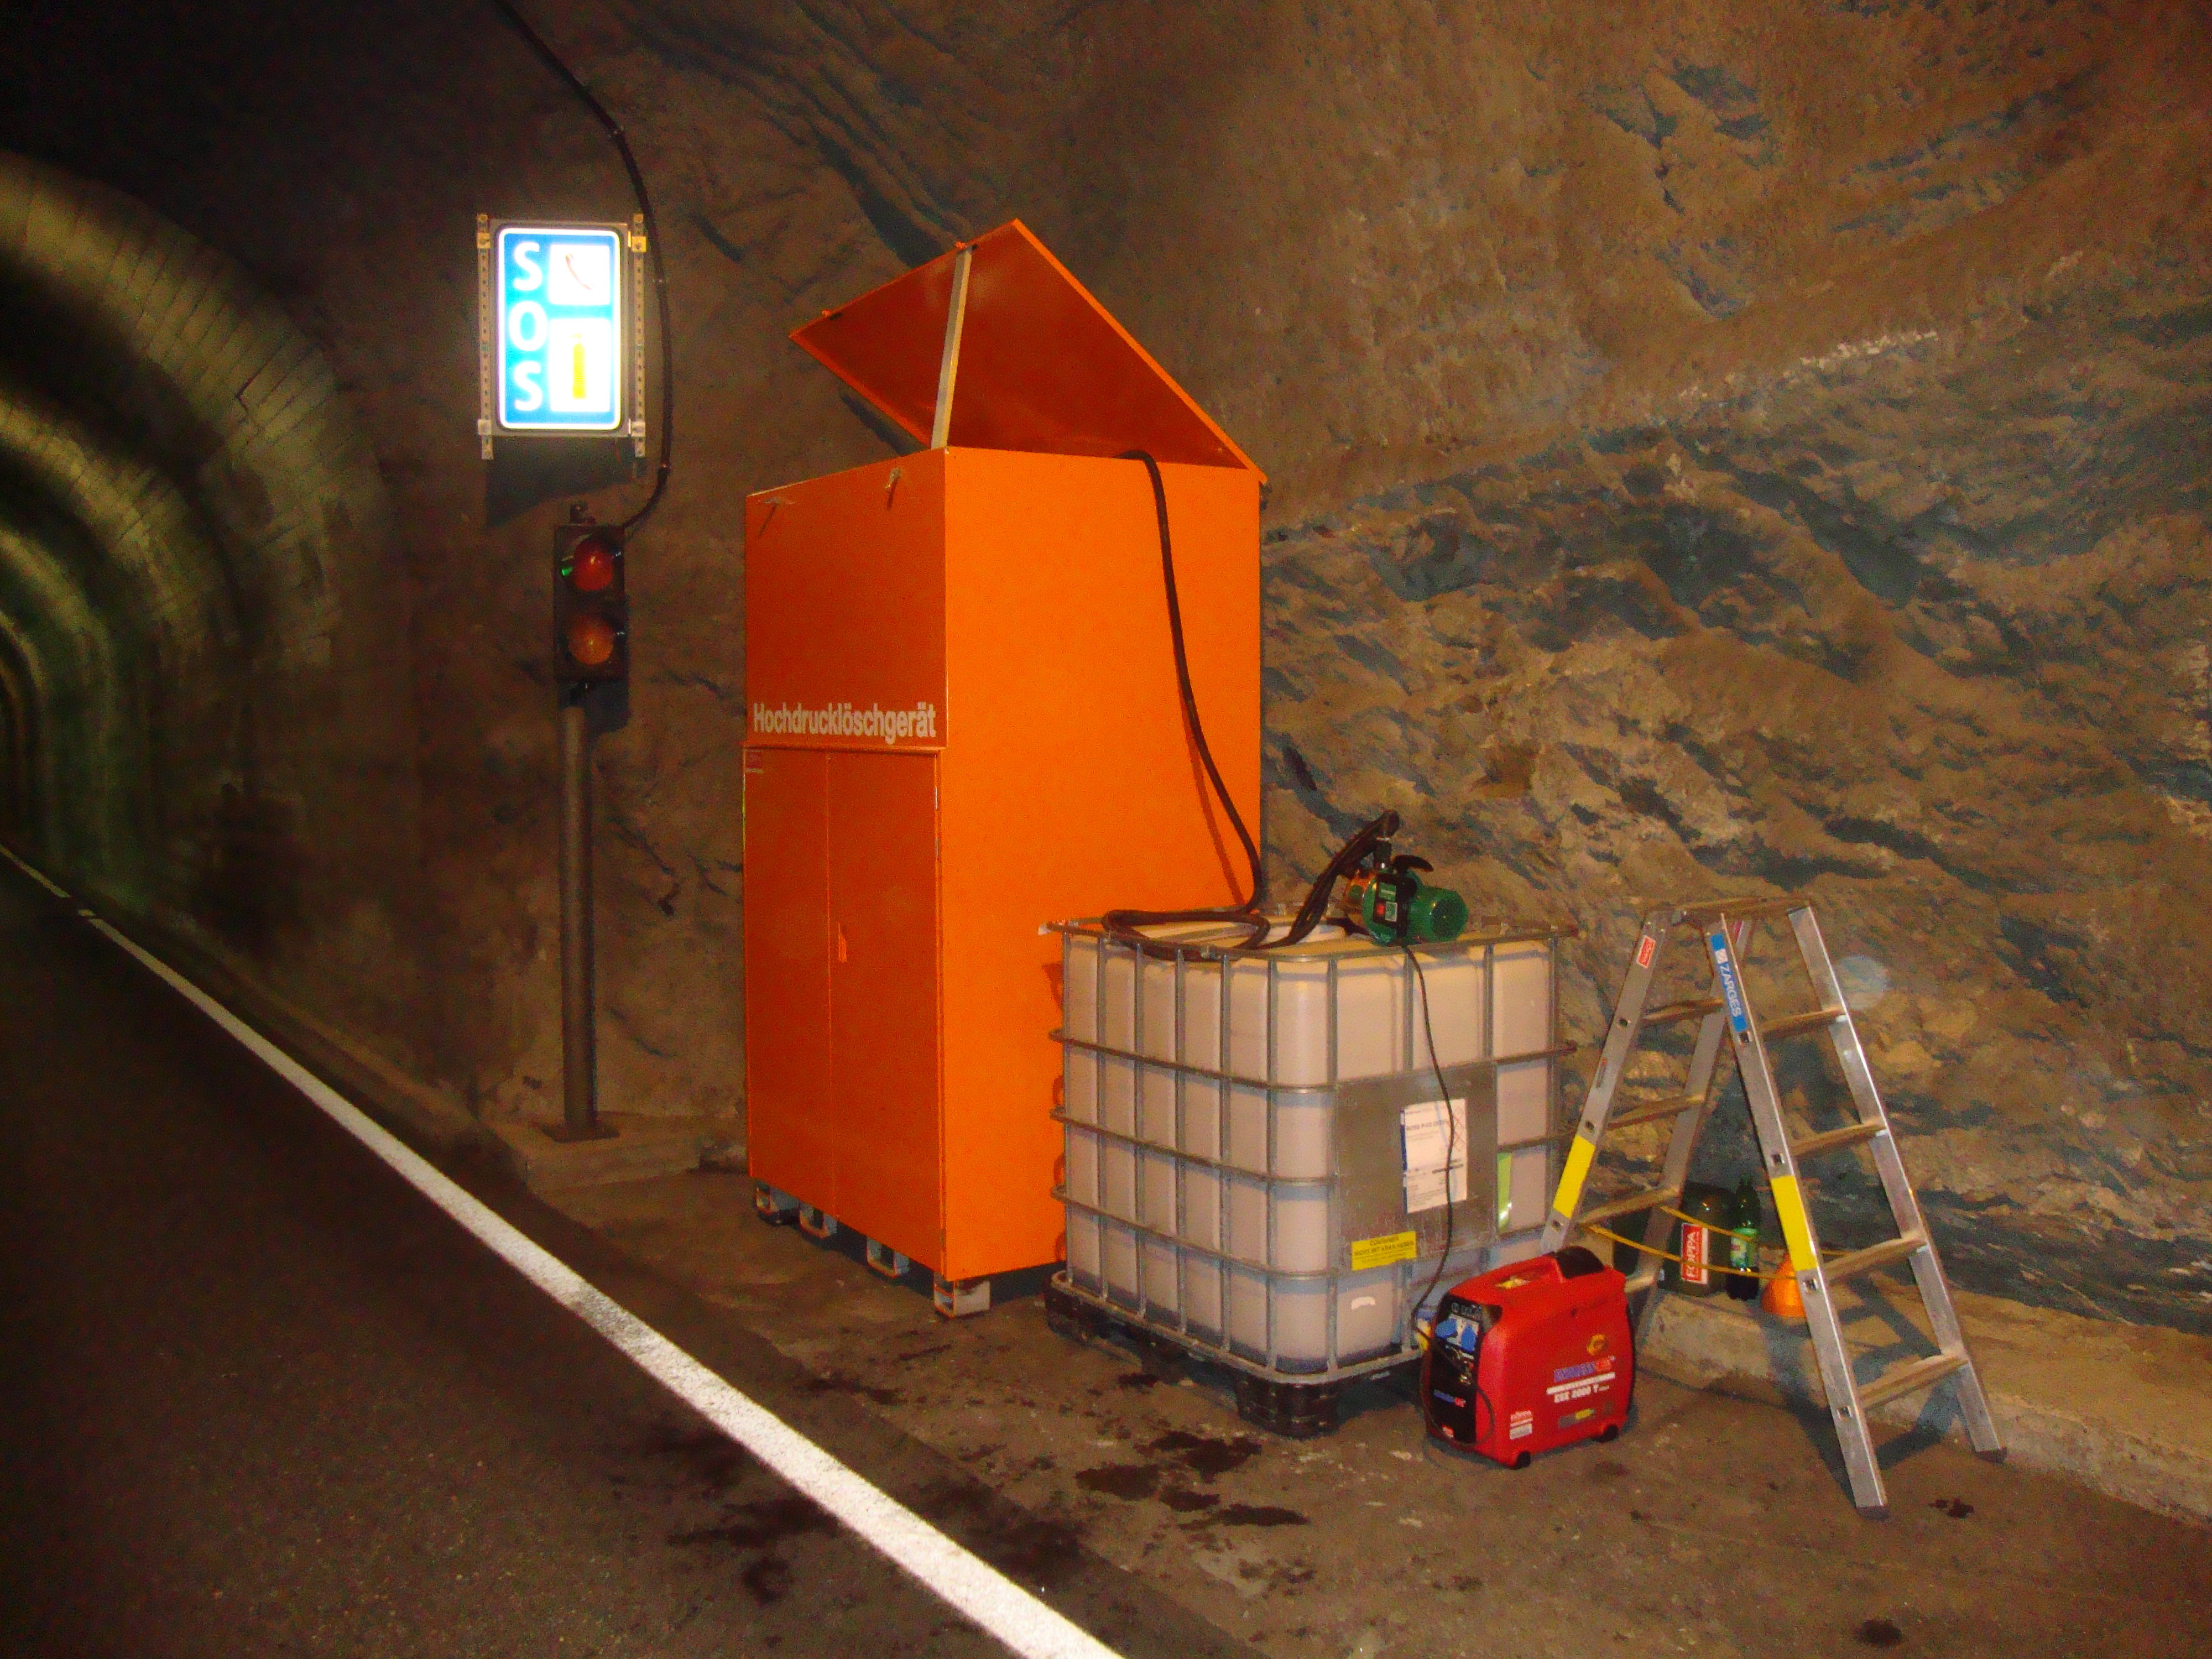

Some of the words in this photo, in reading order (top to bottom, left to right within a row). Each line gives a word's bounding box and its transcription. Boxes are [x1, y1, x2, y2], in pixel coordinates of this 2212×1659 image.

[508, 242, 548, 411] SOS
[753, 701, 936, 745] Hochdrucklöschgerät
[1719, 964, 1742, 1017] ZARGES
